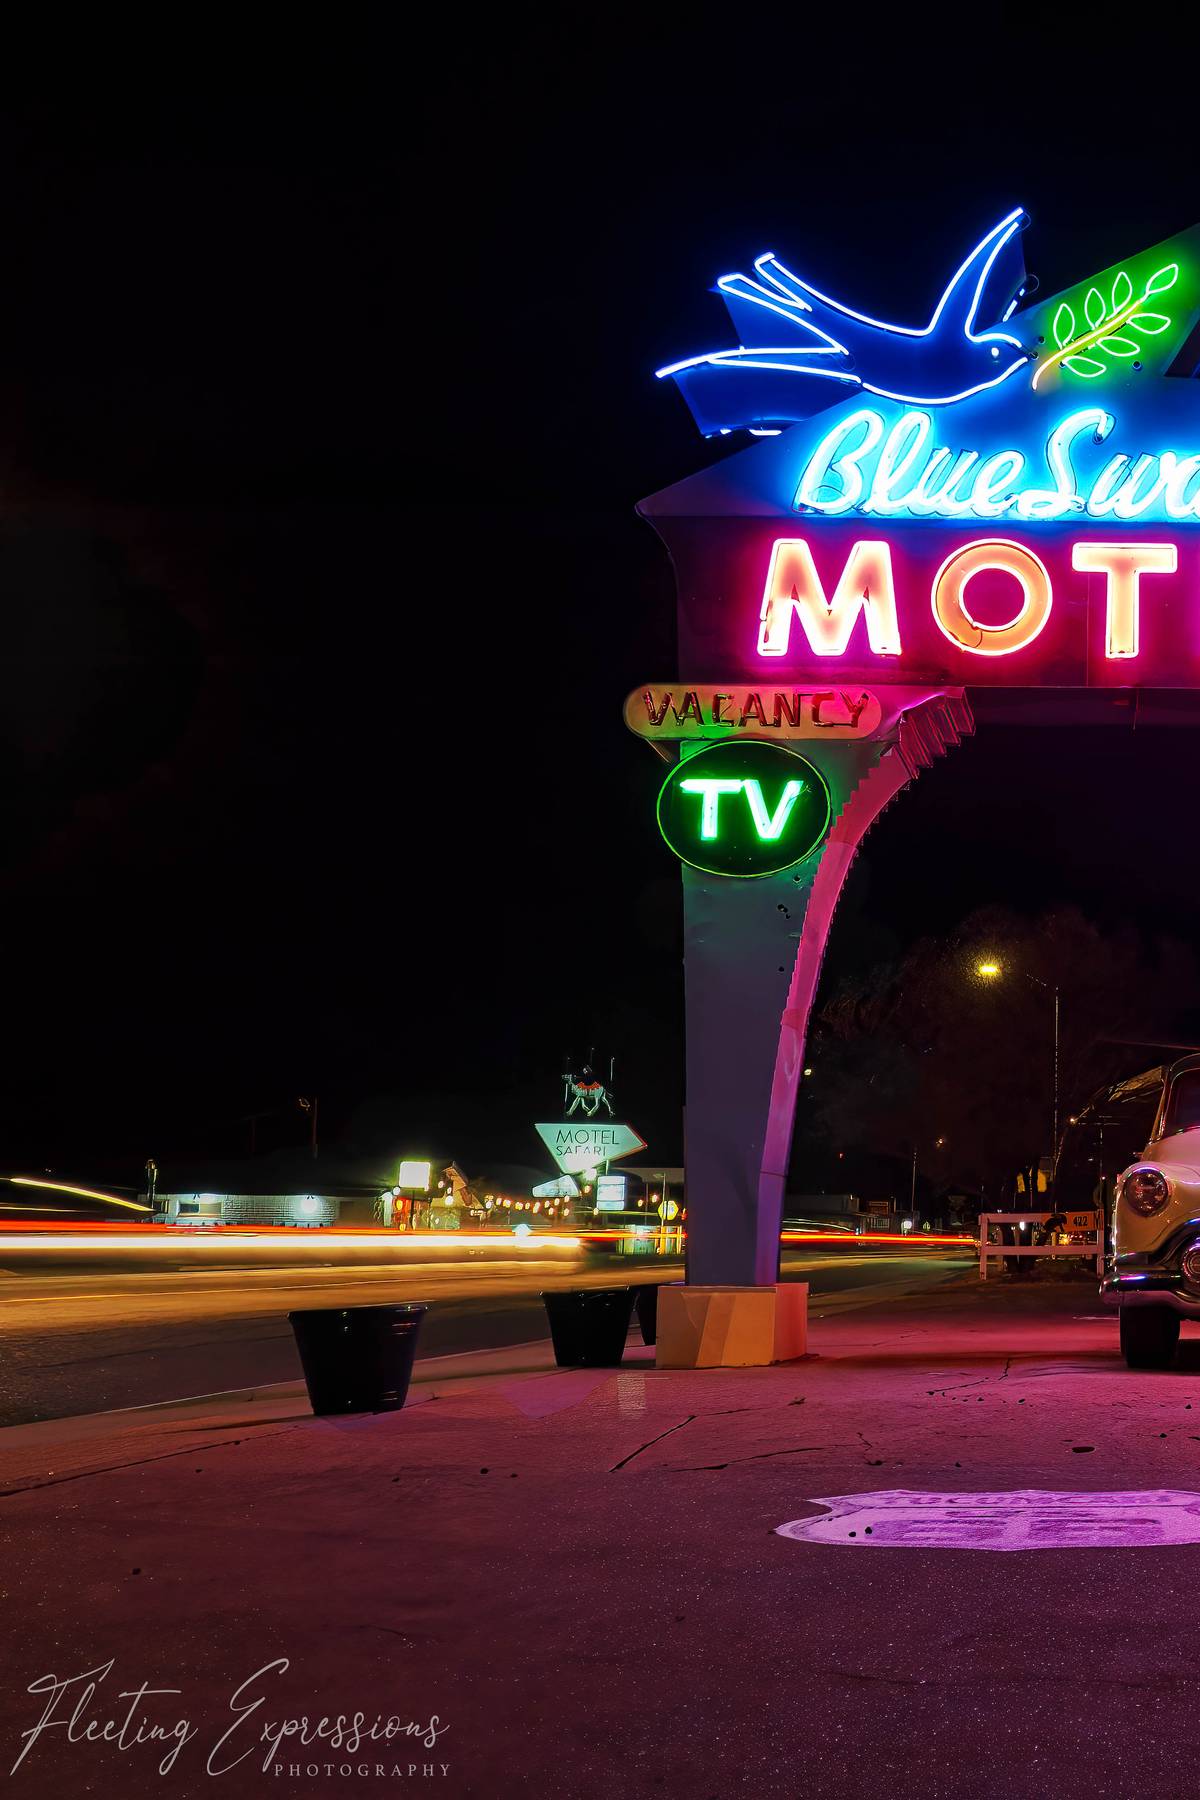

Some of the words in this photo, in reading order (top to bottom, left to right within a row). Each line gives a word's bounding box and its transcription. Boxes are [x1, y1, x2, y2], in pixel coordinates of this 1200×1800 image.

[793, 409, 1019, 516] Blue
[641, 690, 870, 728] VACANCY
[679, 778, 805, 841] TV
[556, 1129, 620, 1145] MOTEL
[556, 1145, 606, 1157] SAFARI
